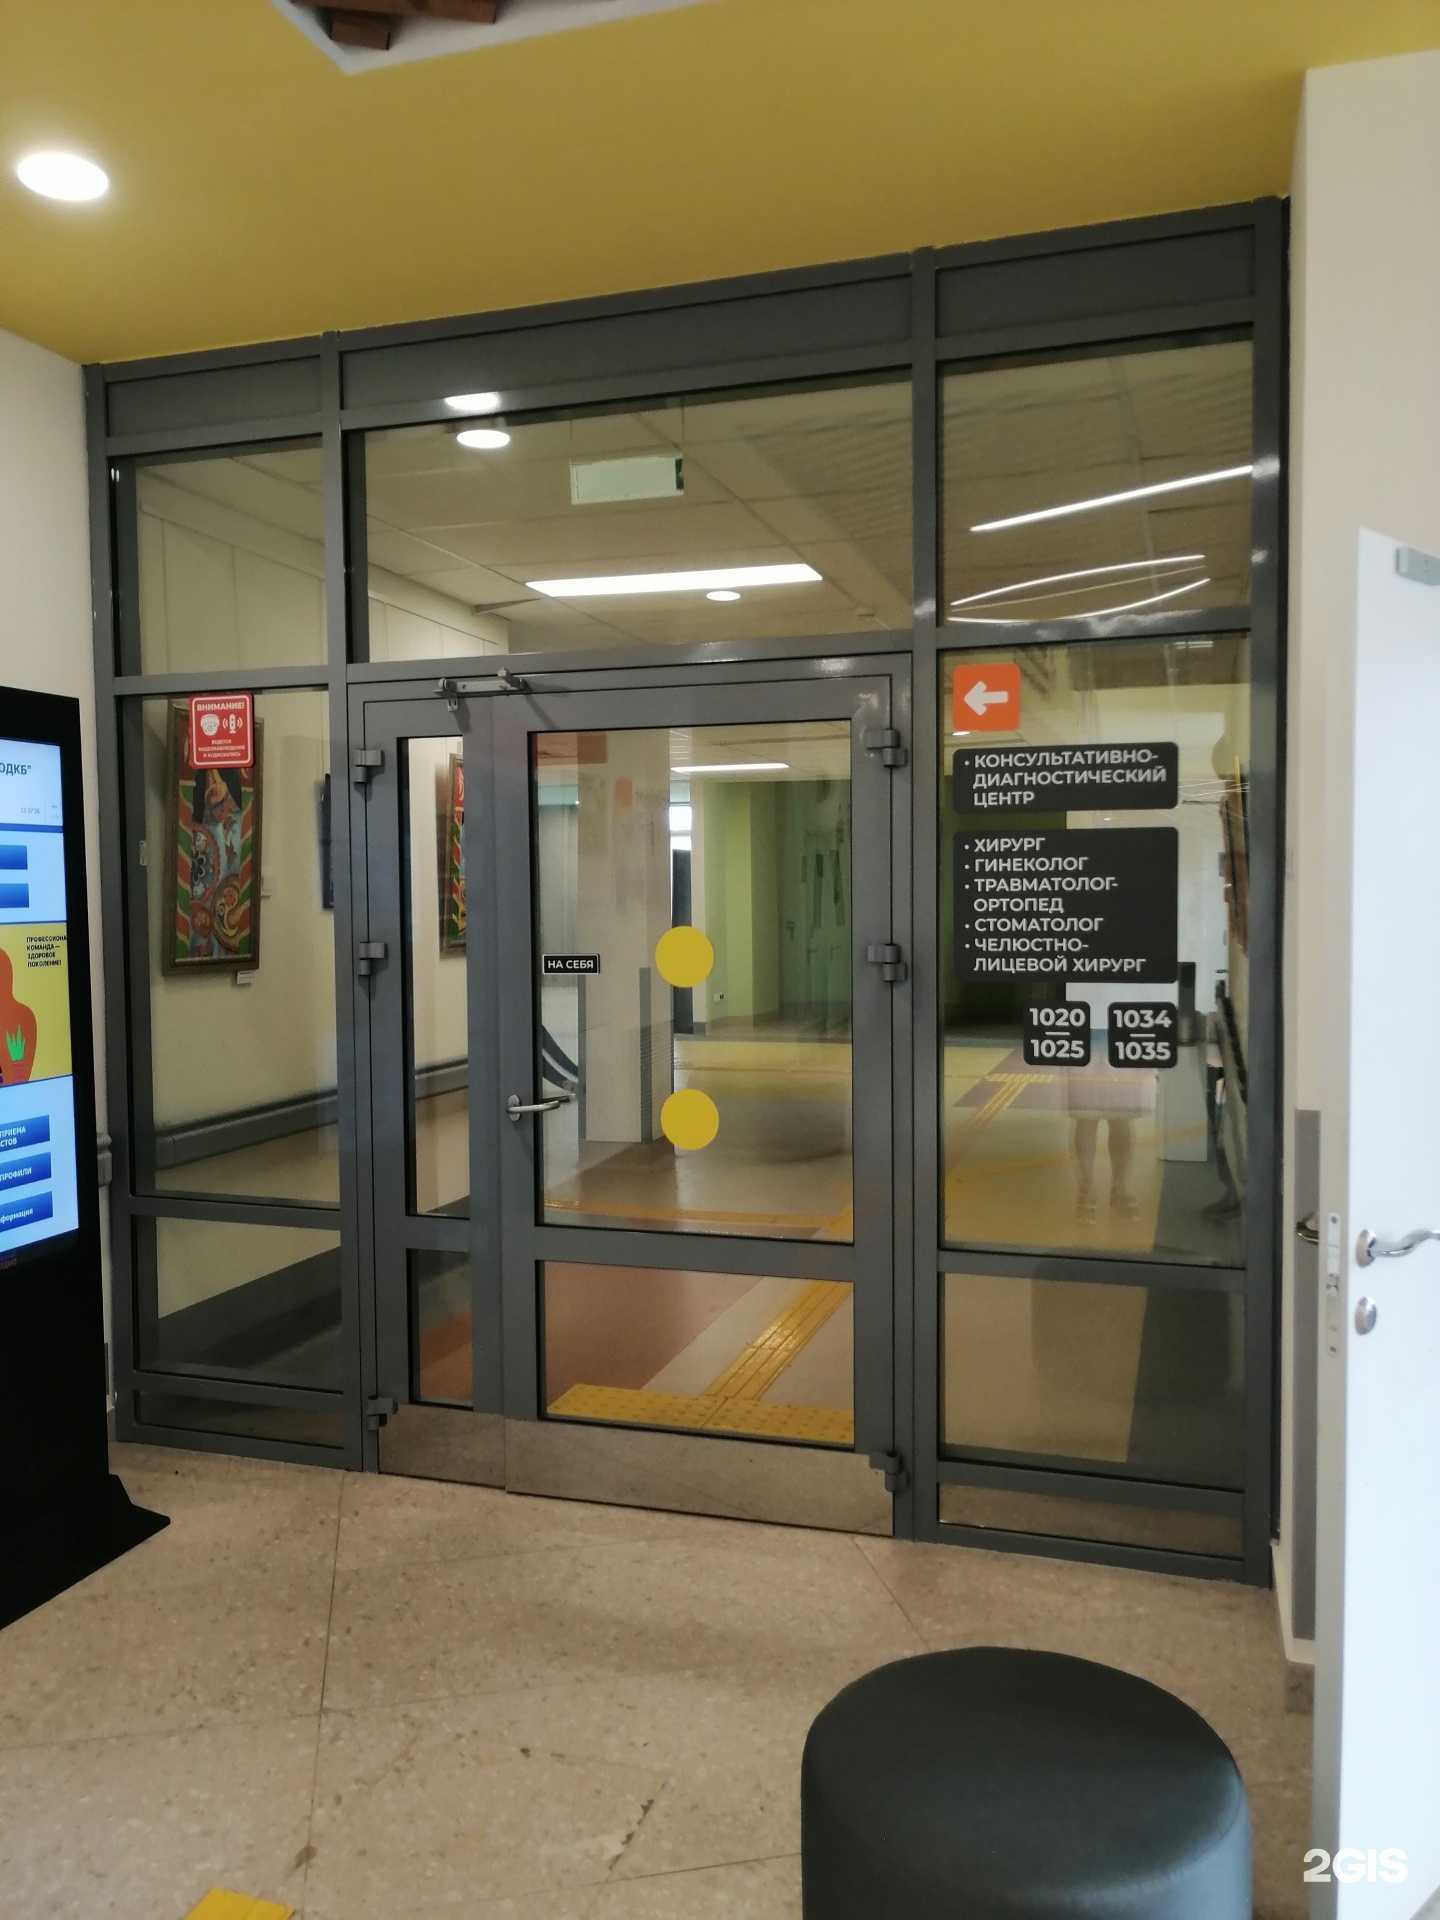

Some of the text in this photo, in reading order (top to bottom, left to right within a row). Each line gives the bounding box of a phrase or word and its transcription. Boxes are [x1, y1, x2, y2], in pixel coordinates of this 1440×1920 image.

[974, 749, 1159, 768] КОНСУЛЬТАТИВНО-
[973, 765, 1167, 789] ДИАГНОСТИЧЕСКИЙ
[973, 791, 1035, 808] ЦЕНТР
[974, 837, 1046, 853] ХИРУРГ
[974, 857, 1088, 872] ГИНЕКОЛОГ
[974, 877, 1119, 892] ТРАВМАТОЛОГ-
[973, 897, 1064, 913] ОРТОПЕД
[974, 917, 1104, 932] СТОМАТОЛОГ
[974, 937, 1089, 952] ЧЕЛЮСТНО-
[547, 960, 594, 969] НА СЕБЯ
[973, 955, 1146, 973] ЛИЦЕВОЙ ХИРУРГ
[1029, 1008, 1086, 1027] 1020
[1113, 1010, 1172, 1028] 1034
[1030, 1039, 1085, 1058] 1025
[1115, 1041, 1171, 1060] 1035
